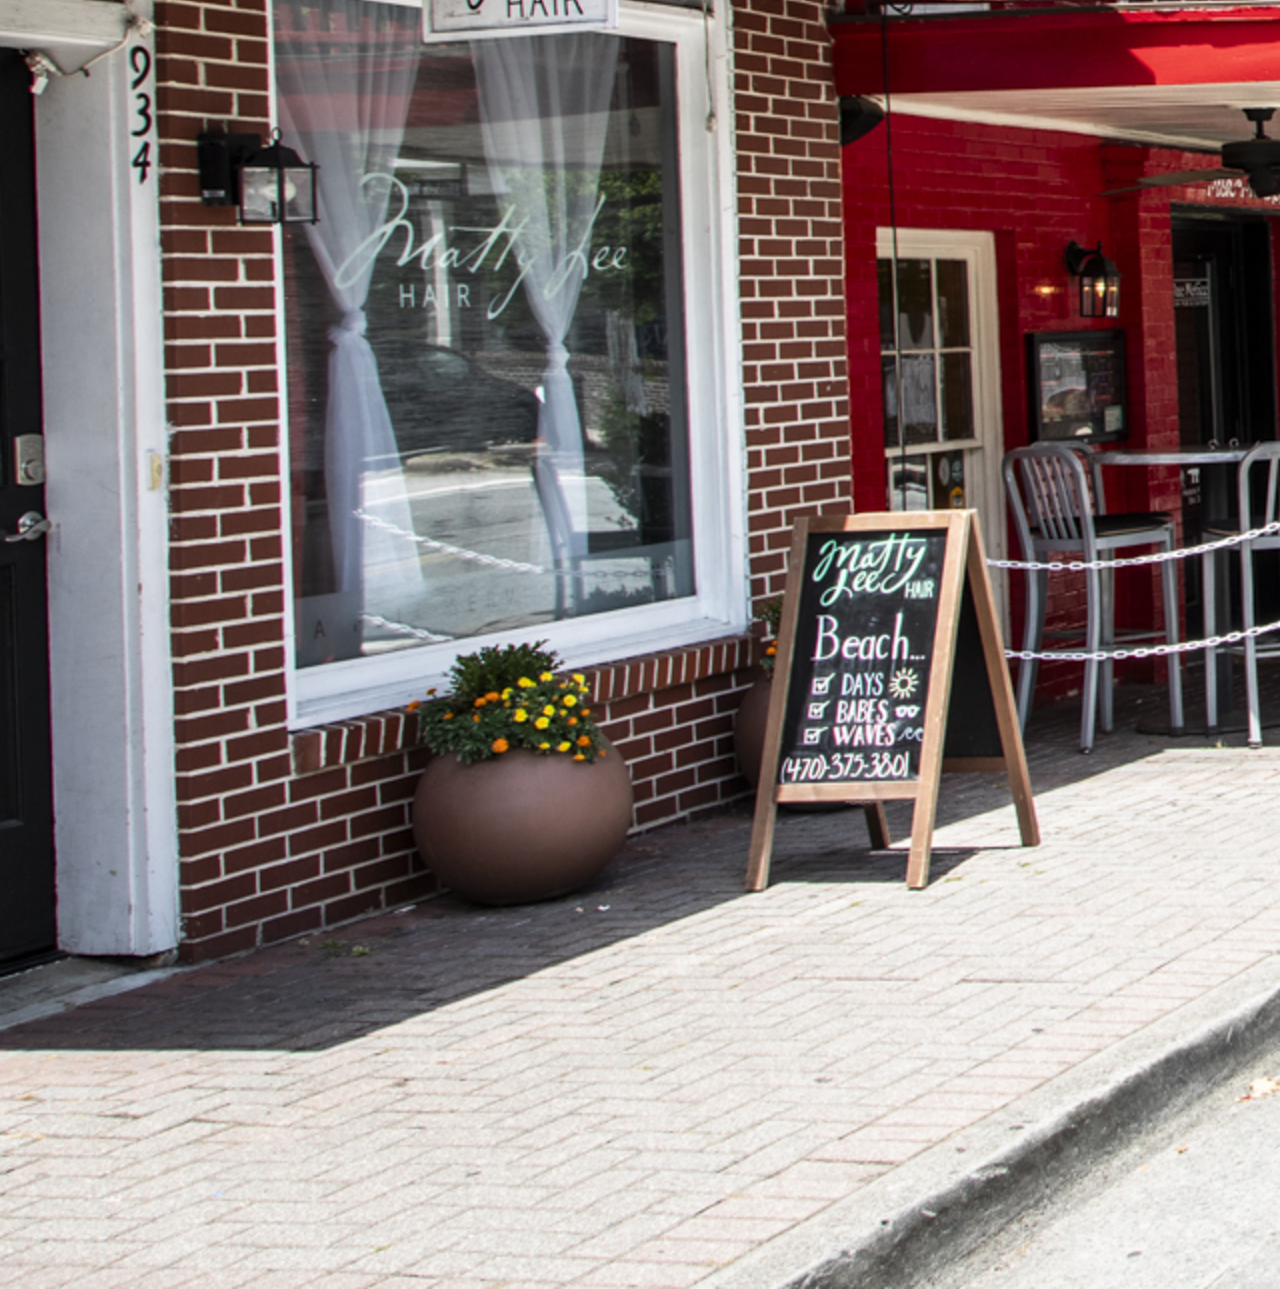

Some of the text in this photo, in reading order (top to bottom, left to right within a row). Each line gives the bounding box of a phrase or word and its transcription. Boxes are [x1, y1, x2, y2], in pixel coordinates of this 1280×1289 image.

[129, 45, 153, 185] 934
[334, 172, 630, 321] Matty Lee
[399, 284, 471, 308] HAIR
[811, 532, 928, 594] Matty
[820, 568, 882, 607] Lee
[904, 580, 935, 599] HAIR
[840, 672, 884, 696] DAYS
[835, 699, 889, 724] BABES
[833, 724, 896, 747] WAVES
